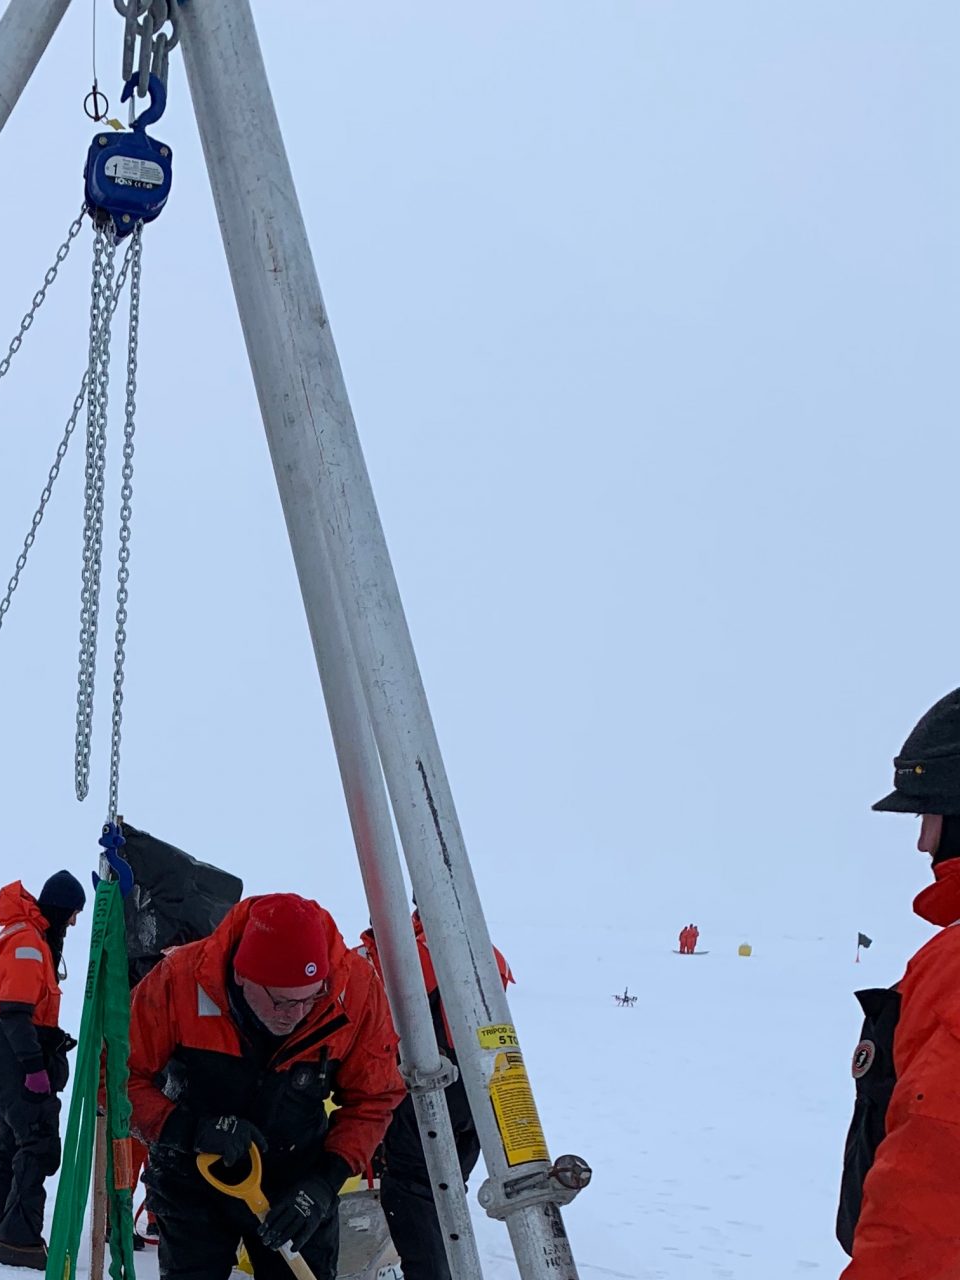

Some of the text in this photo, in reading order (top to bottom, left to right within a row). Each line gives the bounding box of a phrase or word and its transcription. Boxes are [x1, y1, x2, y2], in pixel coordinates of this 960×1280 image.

[113, 162, 118, 176] 1
[481, 1026, 507, 1037] TRIPOD
[499, 1035, 507, 1045] 5
